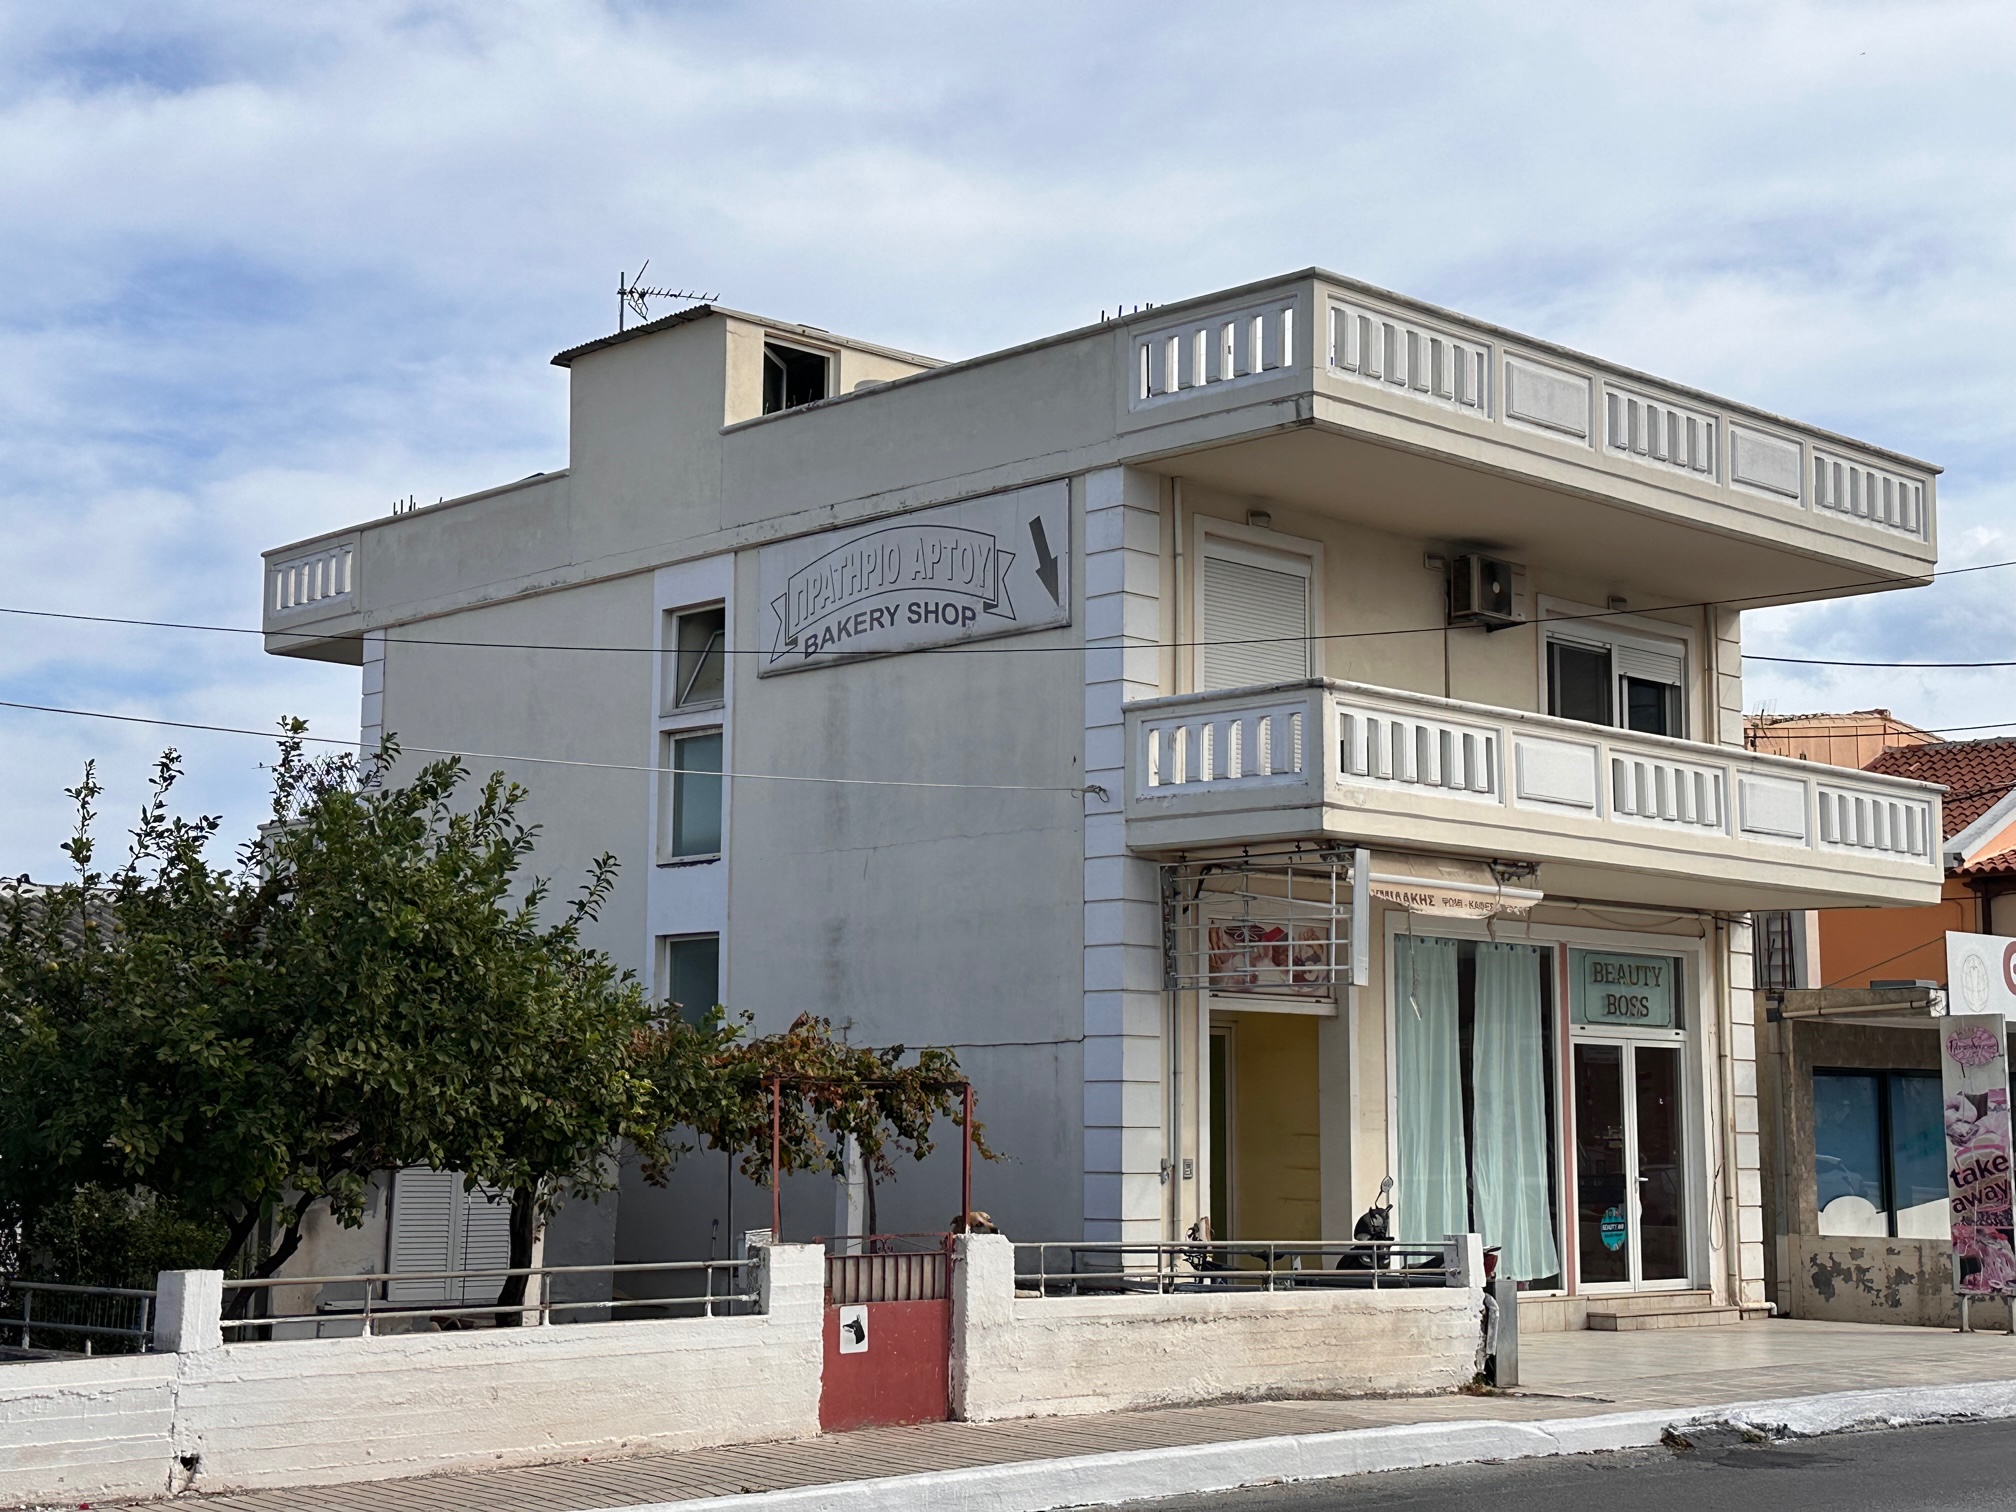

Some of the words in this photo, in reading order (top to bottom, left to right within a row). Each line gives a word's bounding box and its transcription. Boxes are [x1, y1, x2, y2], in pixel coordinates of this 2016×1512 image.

[793, 543, 901, 628] ΠΡΑΤΗΡΙΟ
[911, 537, 992, 588] ΑΡΤΟΥ
[804, 604, 901, 659] BAKERY
[907, 602, 978, 628] SHOP
[1592, 961, 1662, 987] BEAUTY
[1606, 993, 1650, 1018] BOSS
[1949, 1155, 2010, 1189] take
[1951, 1179, 2009, 1214] away
